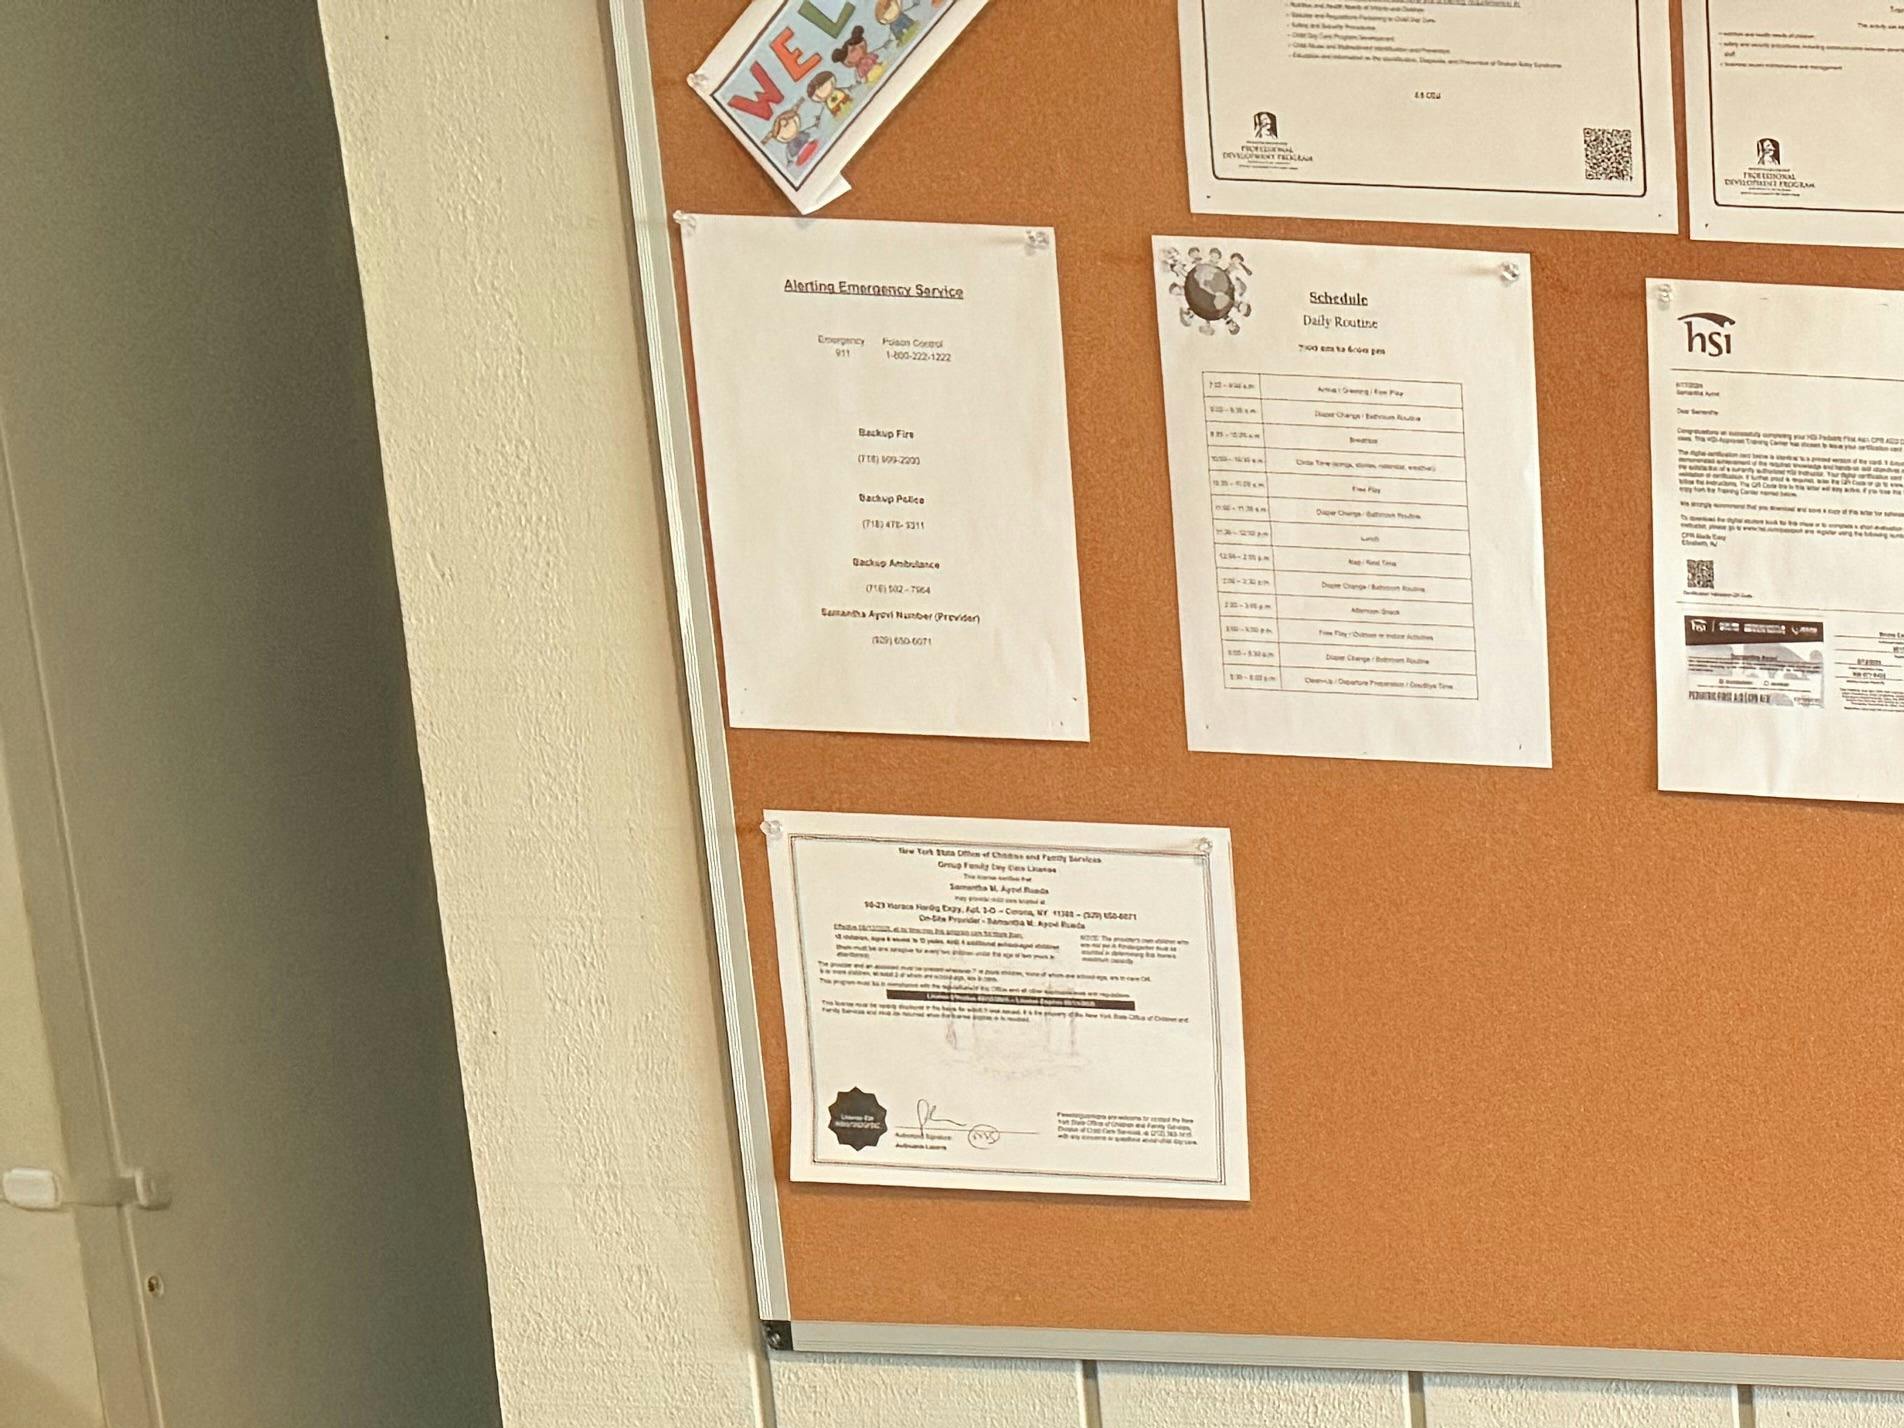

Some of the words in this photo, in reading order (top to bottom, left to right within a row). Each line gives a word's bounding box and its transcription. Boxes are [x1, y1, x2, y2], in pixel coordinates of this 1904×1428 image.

[784, 279, 836, 295] Alerting
[838, 281, 912, 298] Emergency
[915, 283, 964, 299] Service
[1309, 291, 1369, 306] Schedule
[1303, 314, 1332, 329] Daily
[1334, 315, 1379, 330] Routine
[817, 334, 865, 347] Emergency
[912, 338, 944, 349] Control
[1684, 319, 1732, 357] hsi
[858, 427, 895, 439] Backup
[896, 429, 915, 440] Fire
[858, 493, 895, 504] Backup
[896, 494, 925, 505] Police
[852, 557, 887, 569] Backup
[889, 558, 941, 570] Ambulance
[821, 607, 867, 619] Samantha
[868, 609, 894, 621] Ayovi
[896, 610, 933, 621] Number
[934, 611, 981, 624] (Provider)
